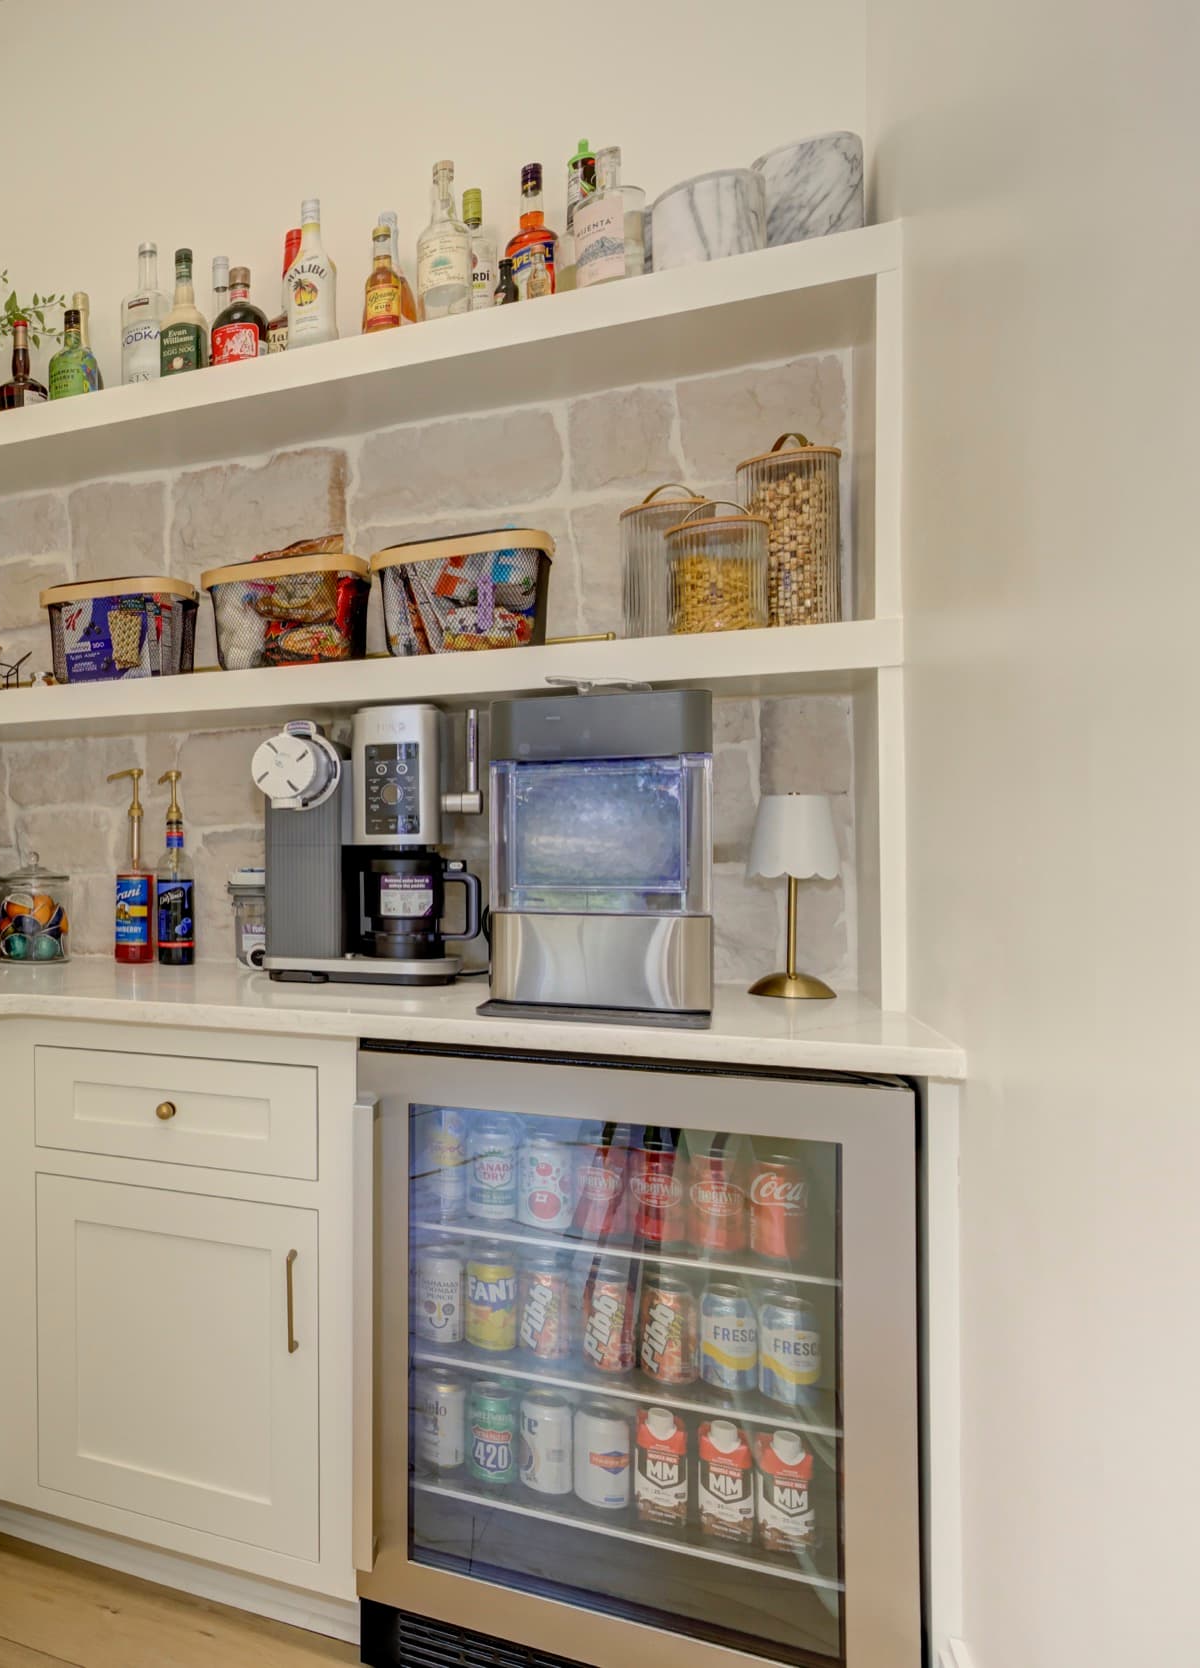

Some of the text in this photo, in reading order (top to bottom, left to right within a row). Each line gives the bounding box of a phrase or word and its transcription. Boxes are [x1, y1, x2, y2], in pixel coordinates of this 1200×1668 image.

[163, 335, 194, 346] Williams
[168, 329, 188, 337] Evan
[482, 1171, 506, 1180] DRY
[468, 1275, 515, 1303] FANT
[520, 1285, 552, 1349] Pibb
[583, 1295, 618, 1364] Pibb
[641, 1303, 674, 1373] Pibb
[713, 1326, 757, 1342] FRESC
[773, 1338, 817, 1356] FRESC
[474, 1442, 509, 1470] 420
